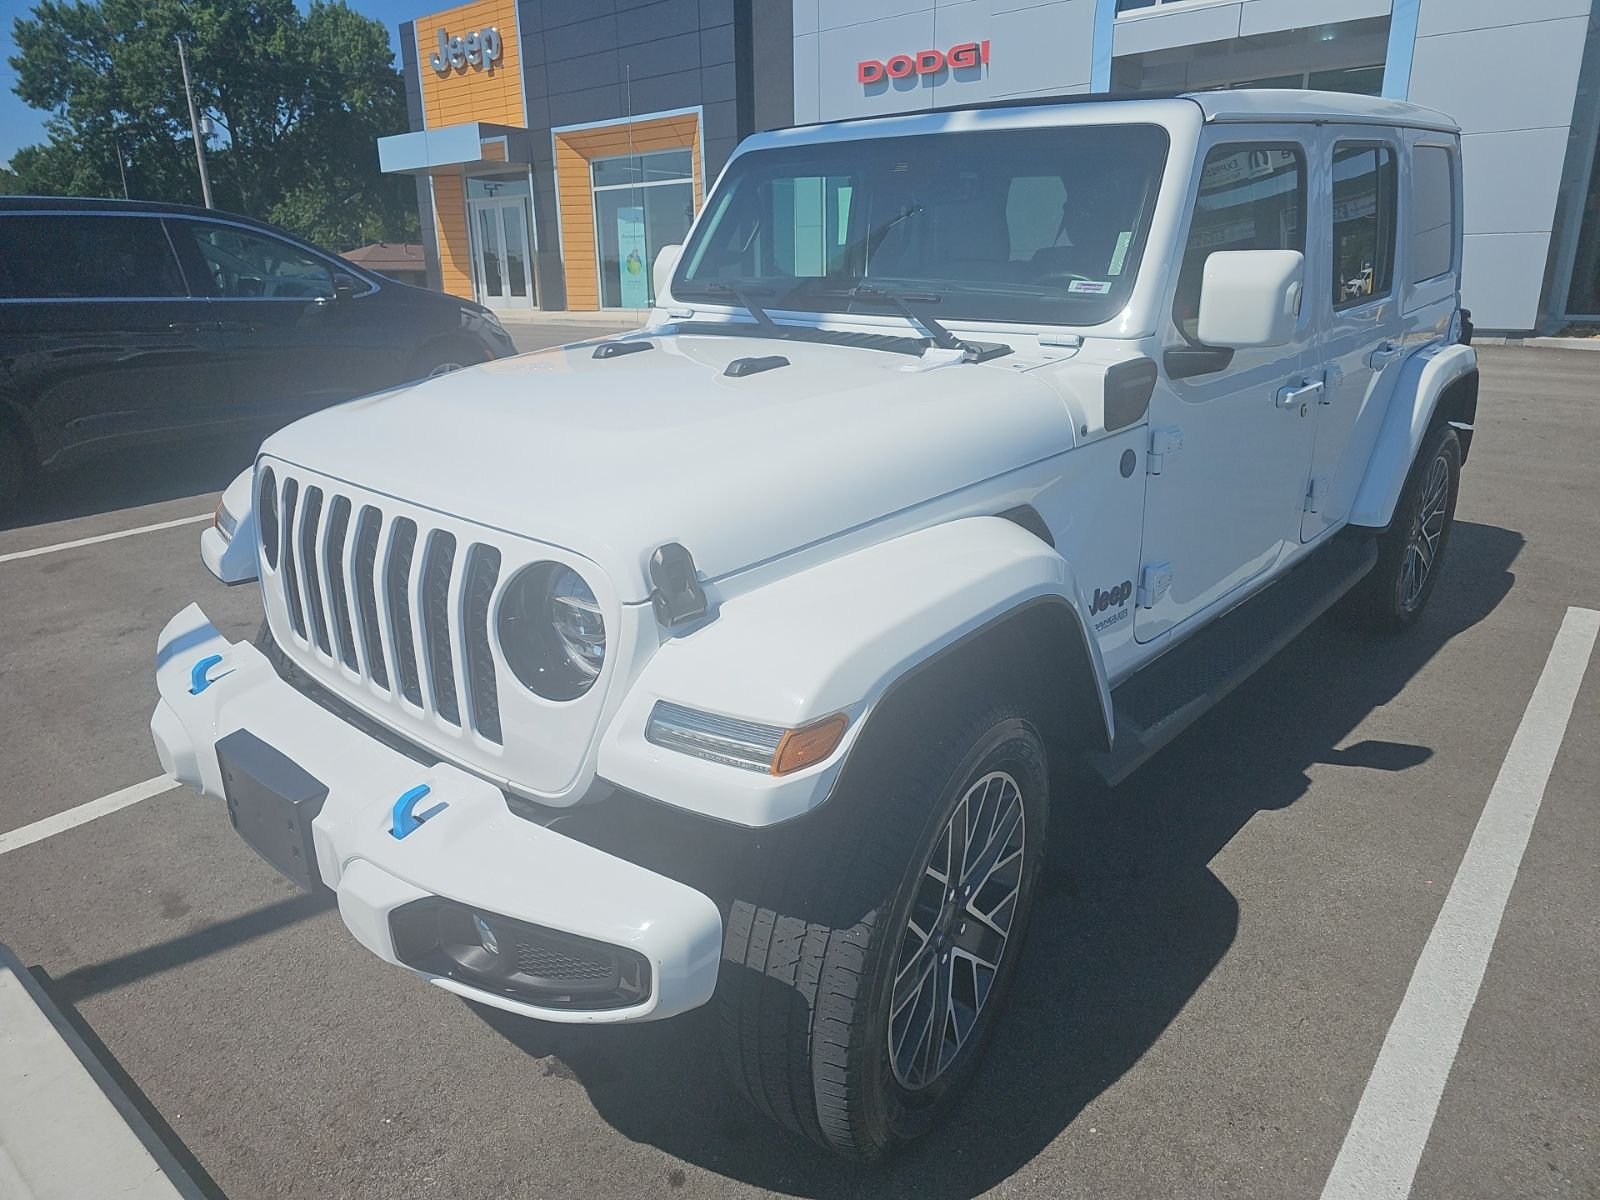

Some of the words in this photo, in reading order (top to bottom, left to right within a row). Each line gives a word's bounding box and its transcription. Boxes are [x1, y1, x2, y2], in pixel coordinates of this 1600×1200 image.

[430, 26, 501, 71] Jeep
[858, 40, 990, 84] DODG
[1088, 580, 1132, 617] Jeep
